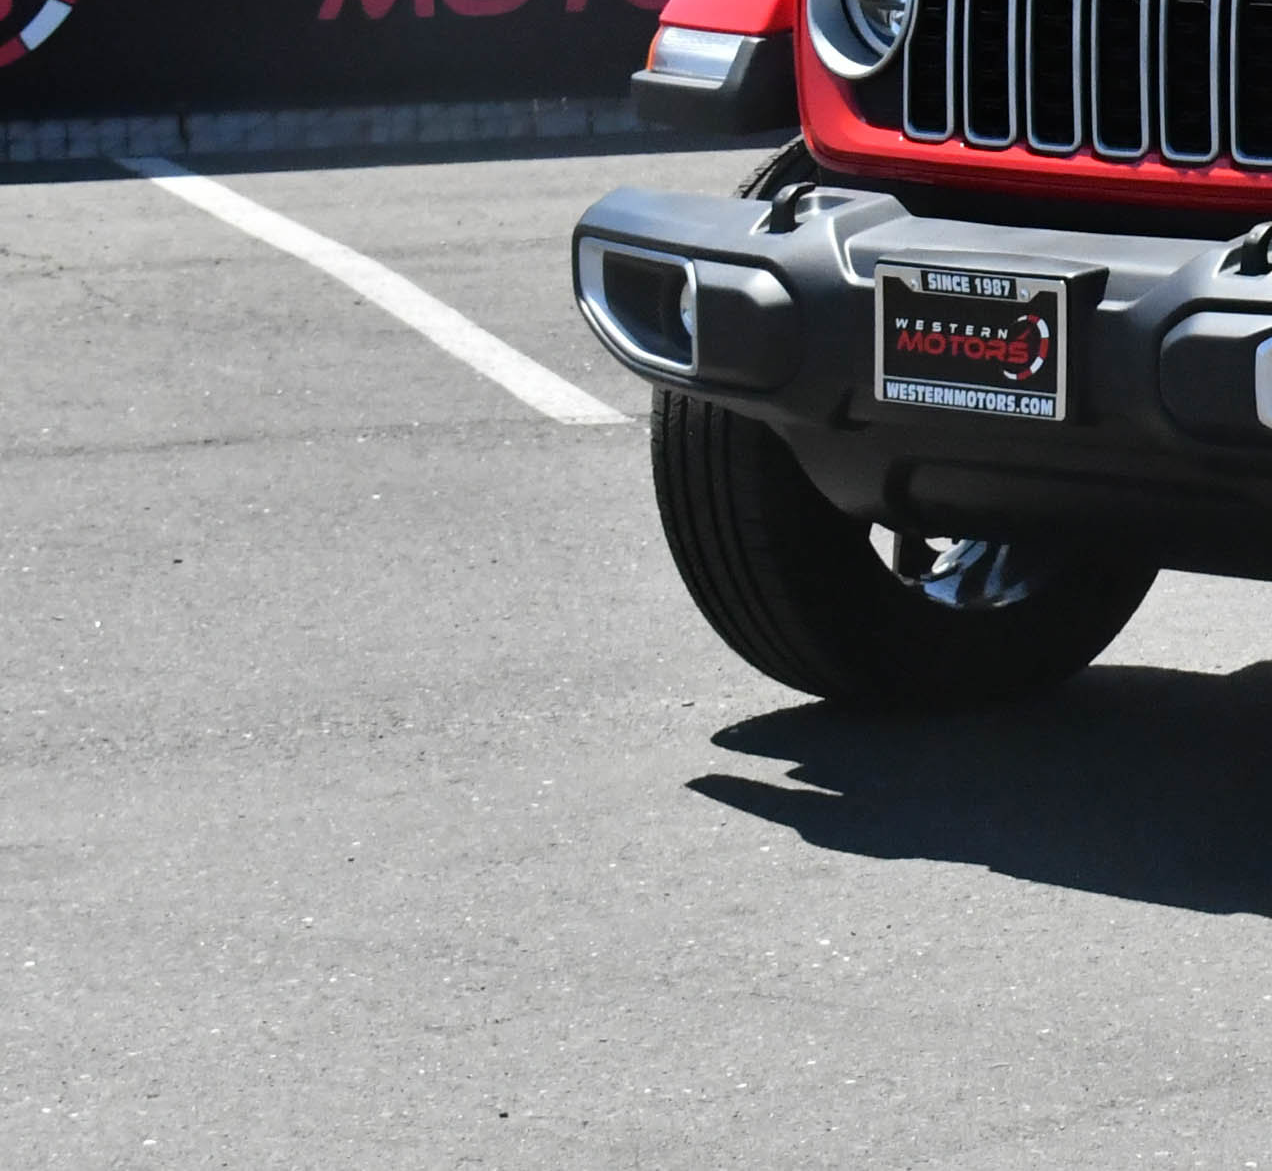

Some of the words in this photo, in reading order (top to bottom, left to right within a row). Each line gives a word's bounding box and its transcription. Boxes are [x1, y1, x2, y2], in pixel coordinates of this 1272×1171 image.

[927, 272, 971, 293] SINCE
[974, 277, 1012, 297] 1987
[895, 317, 1009, 340] WESTERN
[897, 330, 1030, 365] MOTORS
[886, 381, 1054, 417] WESTERNMOTORS.COM
